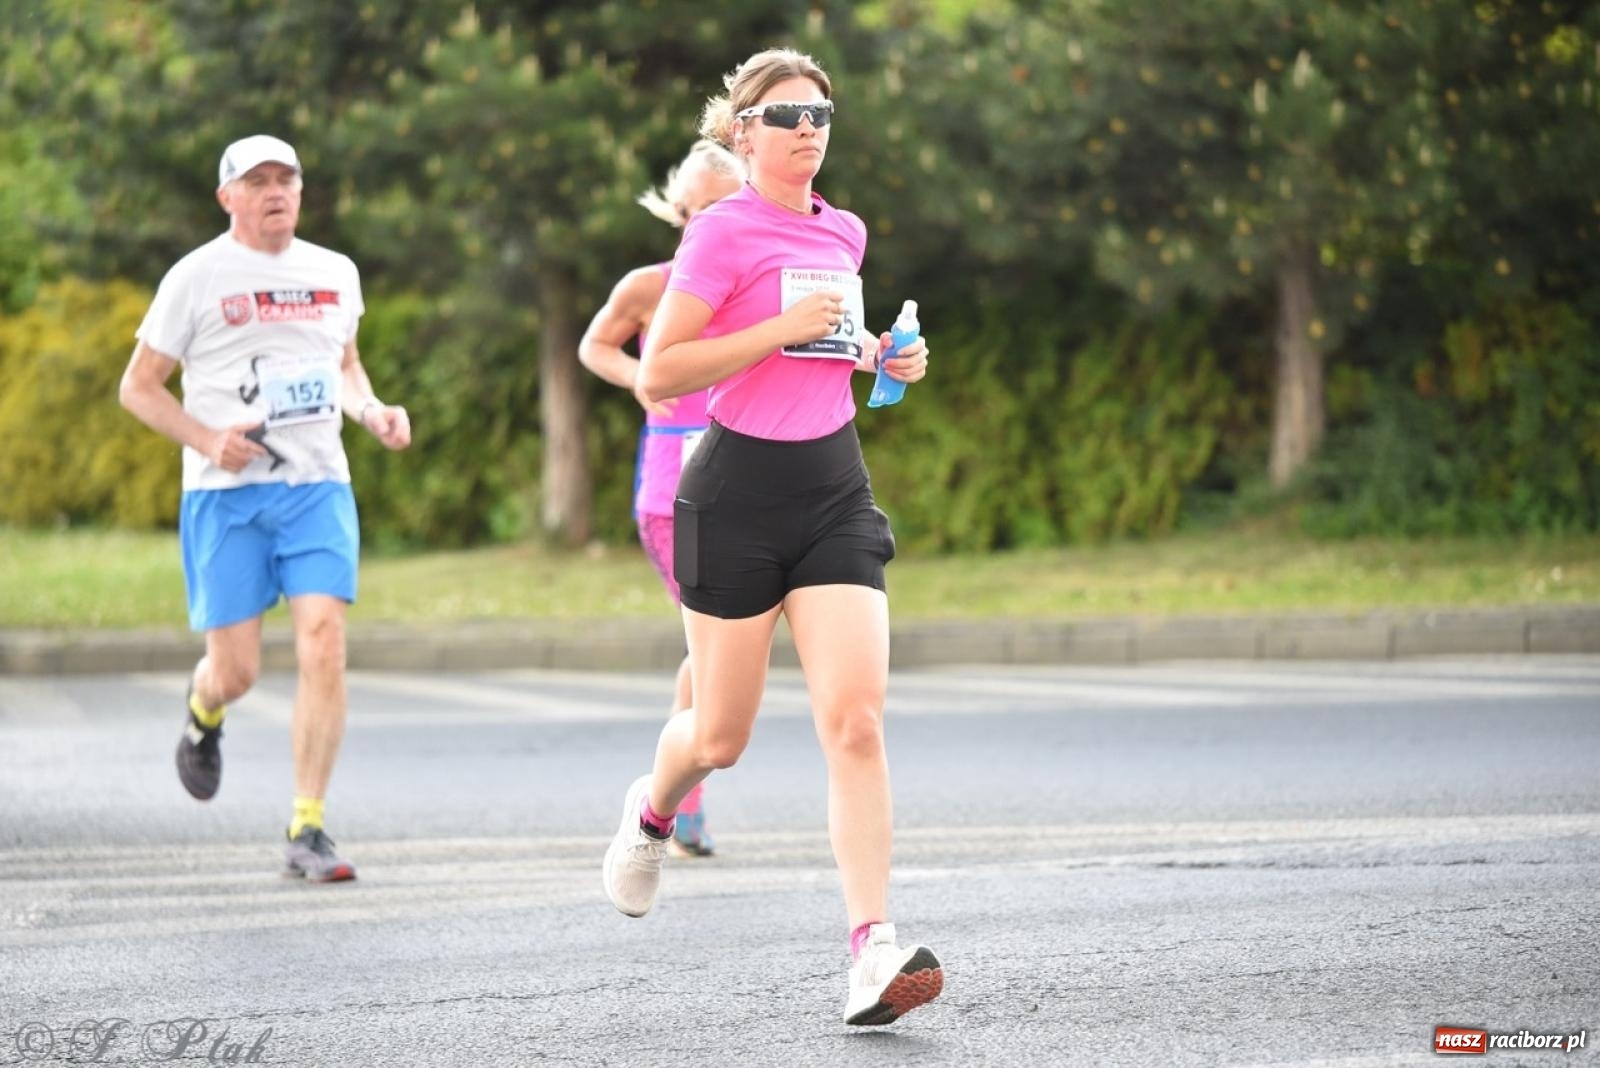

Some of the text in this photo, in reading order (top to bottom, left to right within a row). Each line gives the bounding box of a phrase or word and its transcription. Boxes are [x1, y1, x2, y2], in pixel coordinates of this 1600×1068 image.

[790, 272, 808, 281] XVII
[810, 273, 829, 282] BIEG
[286, 378, 325, 404] 152
